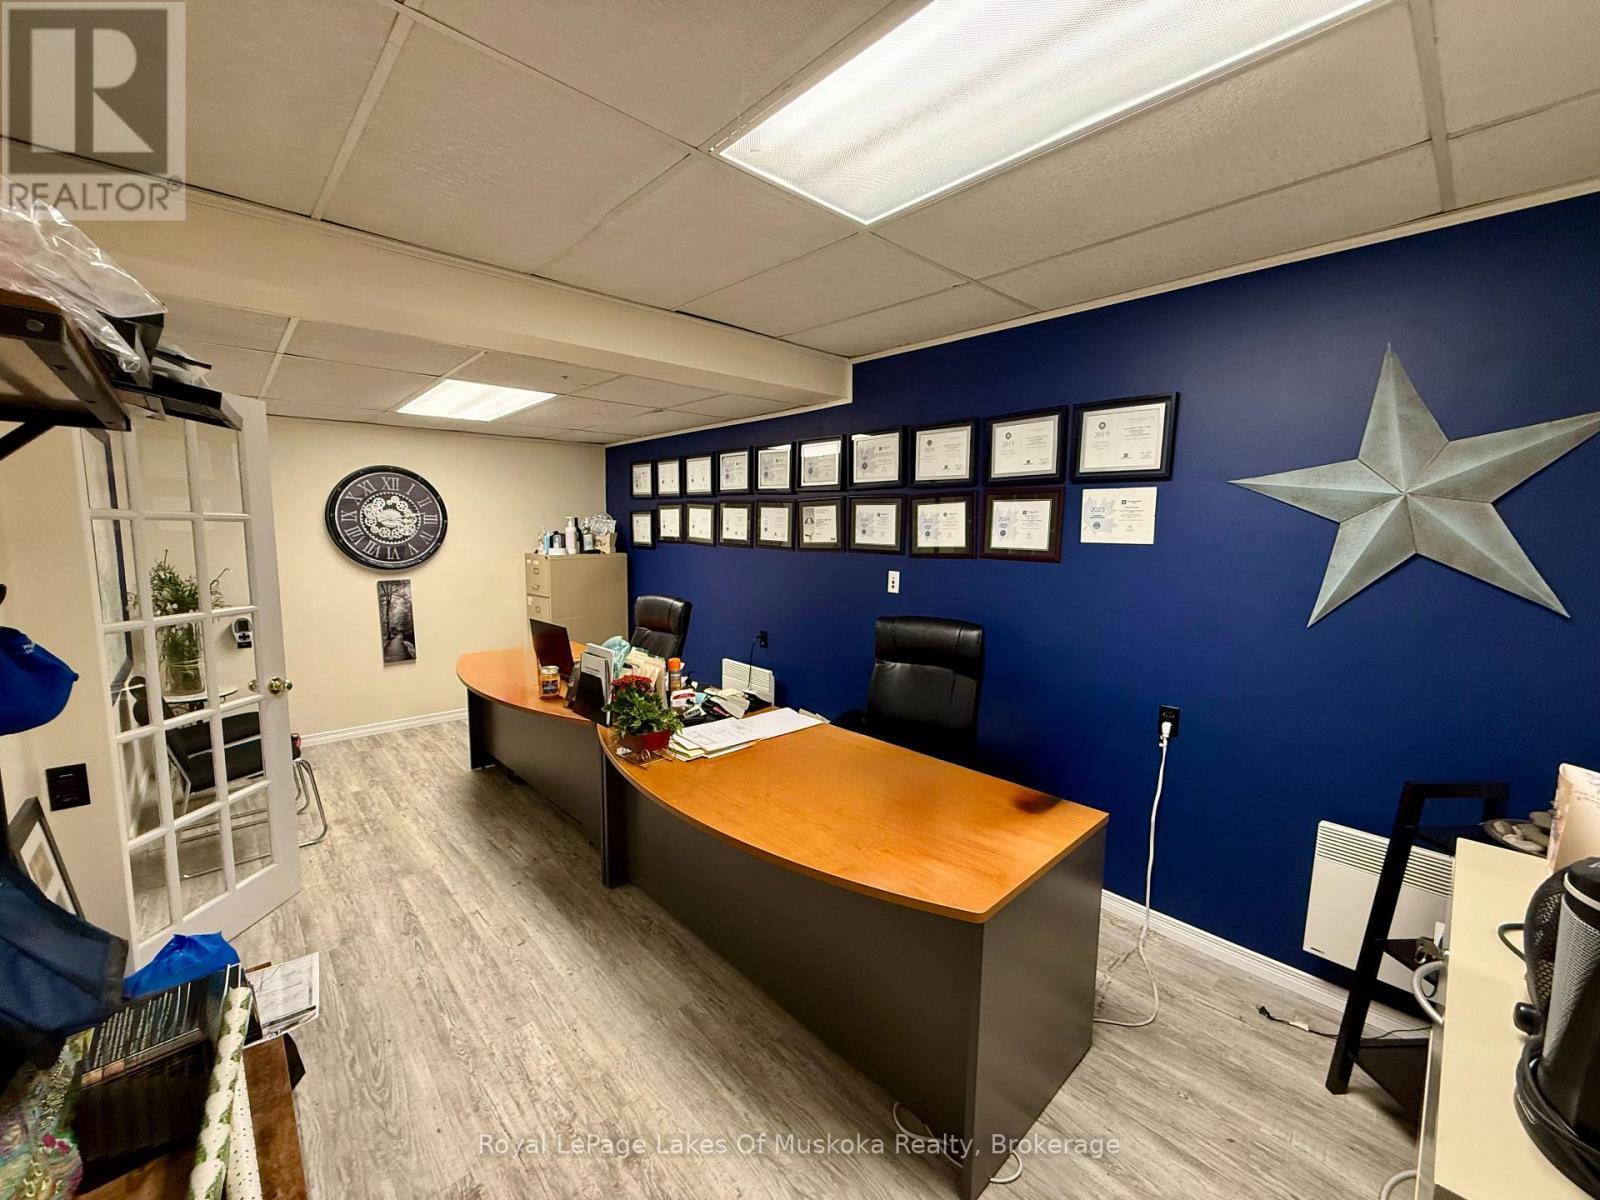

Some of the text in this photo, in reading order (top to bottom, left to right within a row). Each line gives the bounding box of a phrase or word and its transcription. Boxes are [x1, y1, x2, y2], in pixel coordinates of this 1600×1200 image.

[356, 479, 377, 496] XI
[382, 476, 400, 491] XII
[406, 483, 416, 495] I
[344, 491, 363, 506] X
[417, 496, 432, 508] II
[341, 510, 357, 522] IX
[424, 514, 437, 525] III
[345, 525, 365, 546] VIII
[362, 540, 381, 558] VII
[387, 546, 401, 560] VI
[408, 543, 419, 555] V
